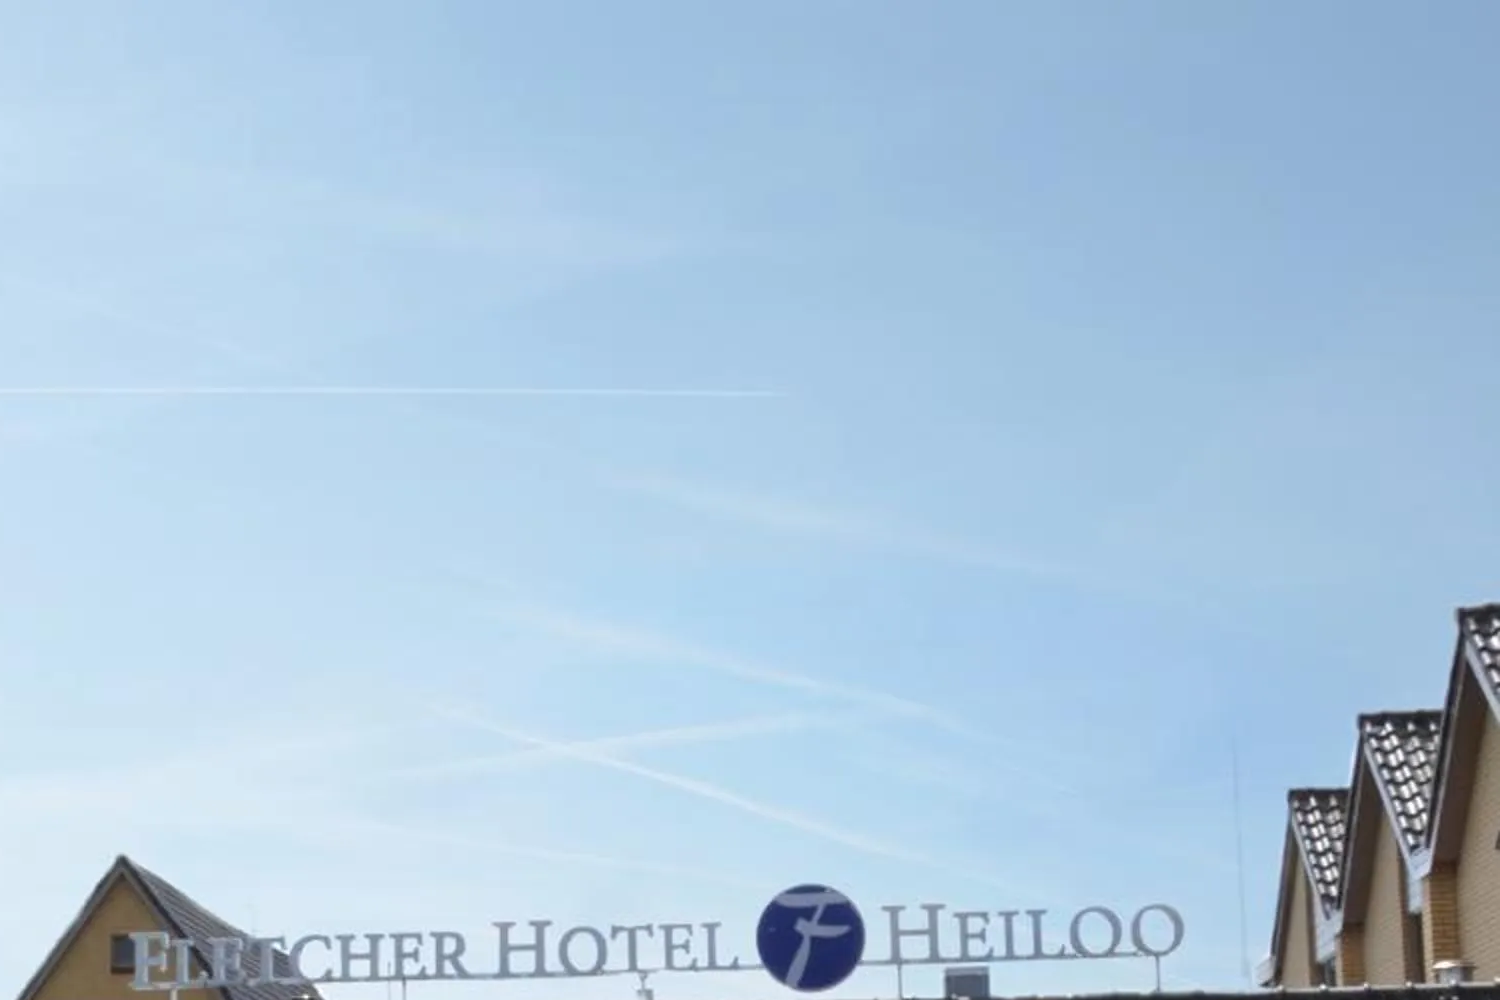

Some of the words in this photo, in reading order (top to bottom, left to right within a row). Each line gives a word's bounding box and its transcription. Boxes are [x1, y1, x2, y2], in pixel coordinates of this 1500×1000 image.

[128, 929, 468, 991] FLETCHER
[492, 919, 740, 979] HOTEL
[881, 903, 1186, 964] HEILOO
